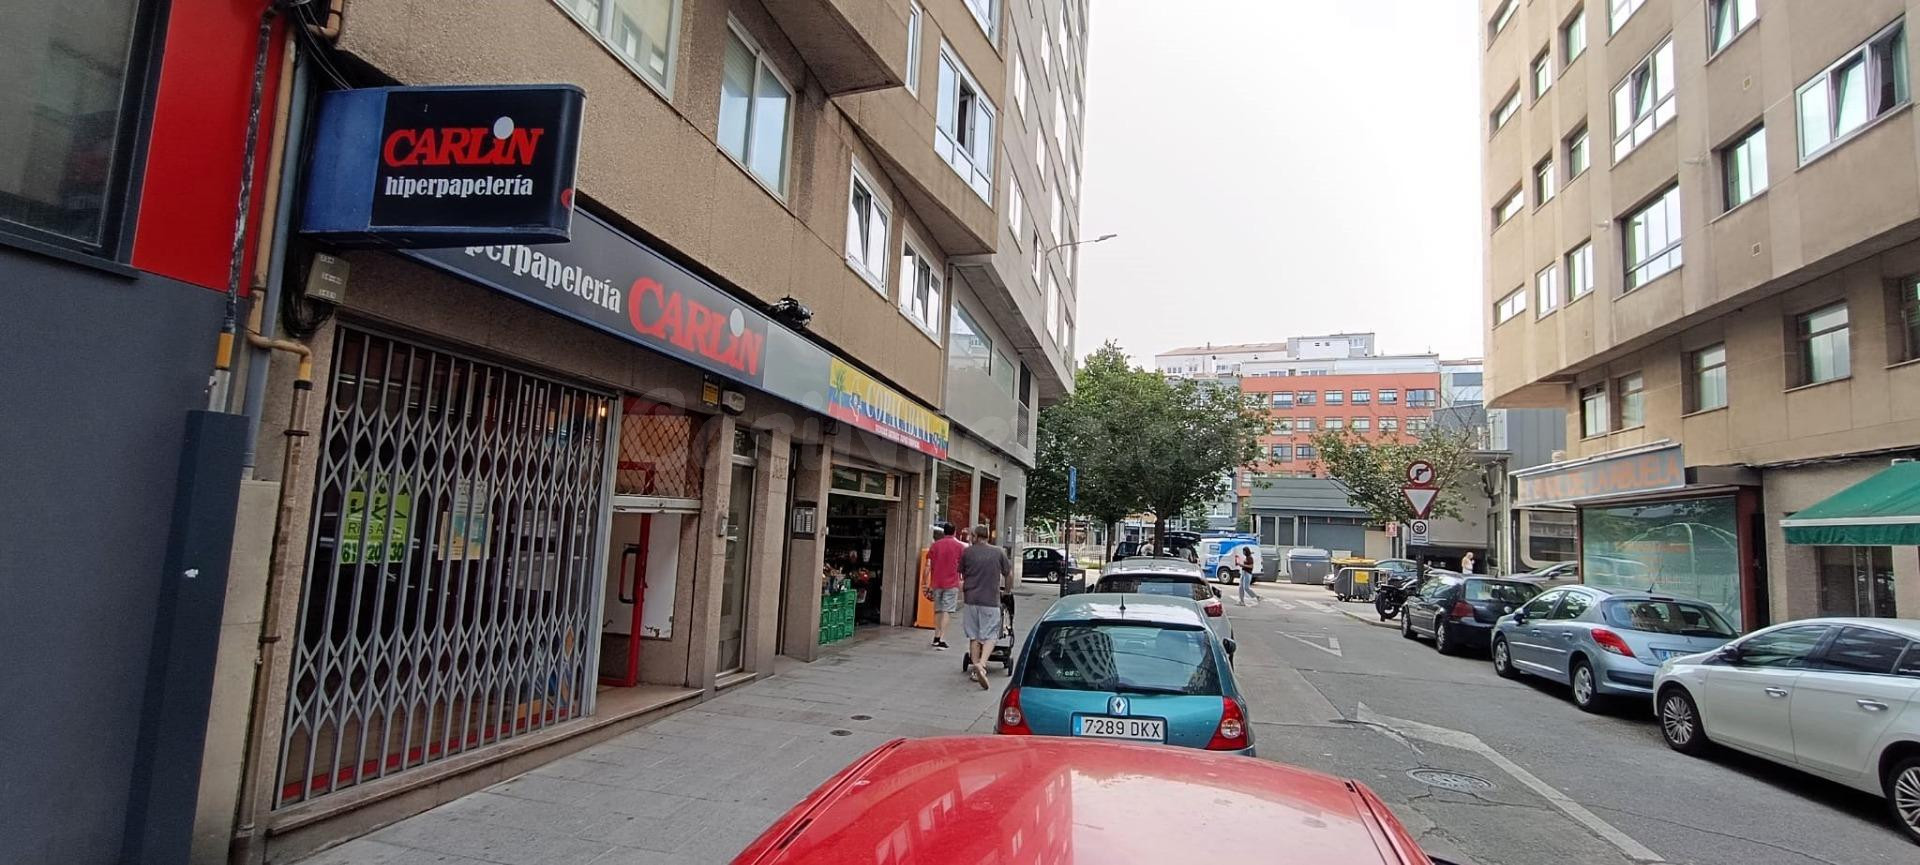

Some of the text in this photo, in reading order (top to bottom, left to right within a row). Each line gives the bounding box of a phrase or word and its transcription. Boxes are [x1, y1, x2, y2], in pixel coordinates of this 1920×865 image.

[385, 174, 534, 199] hiperpapelería
[1085, 719, 1160, 738] 7289 DKX
